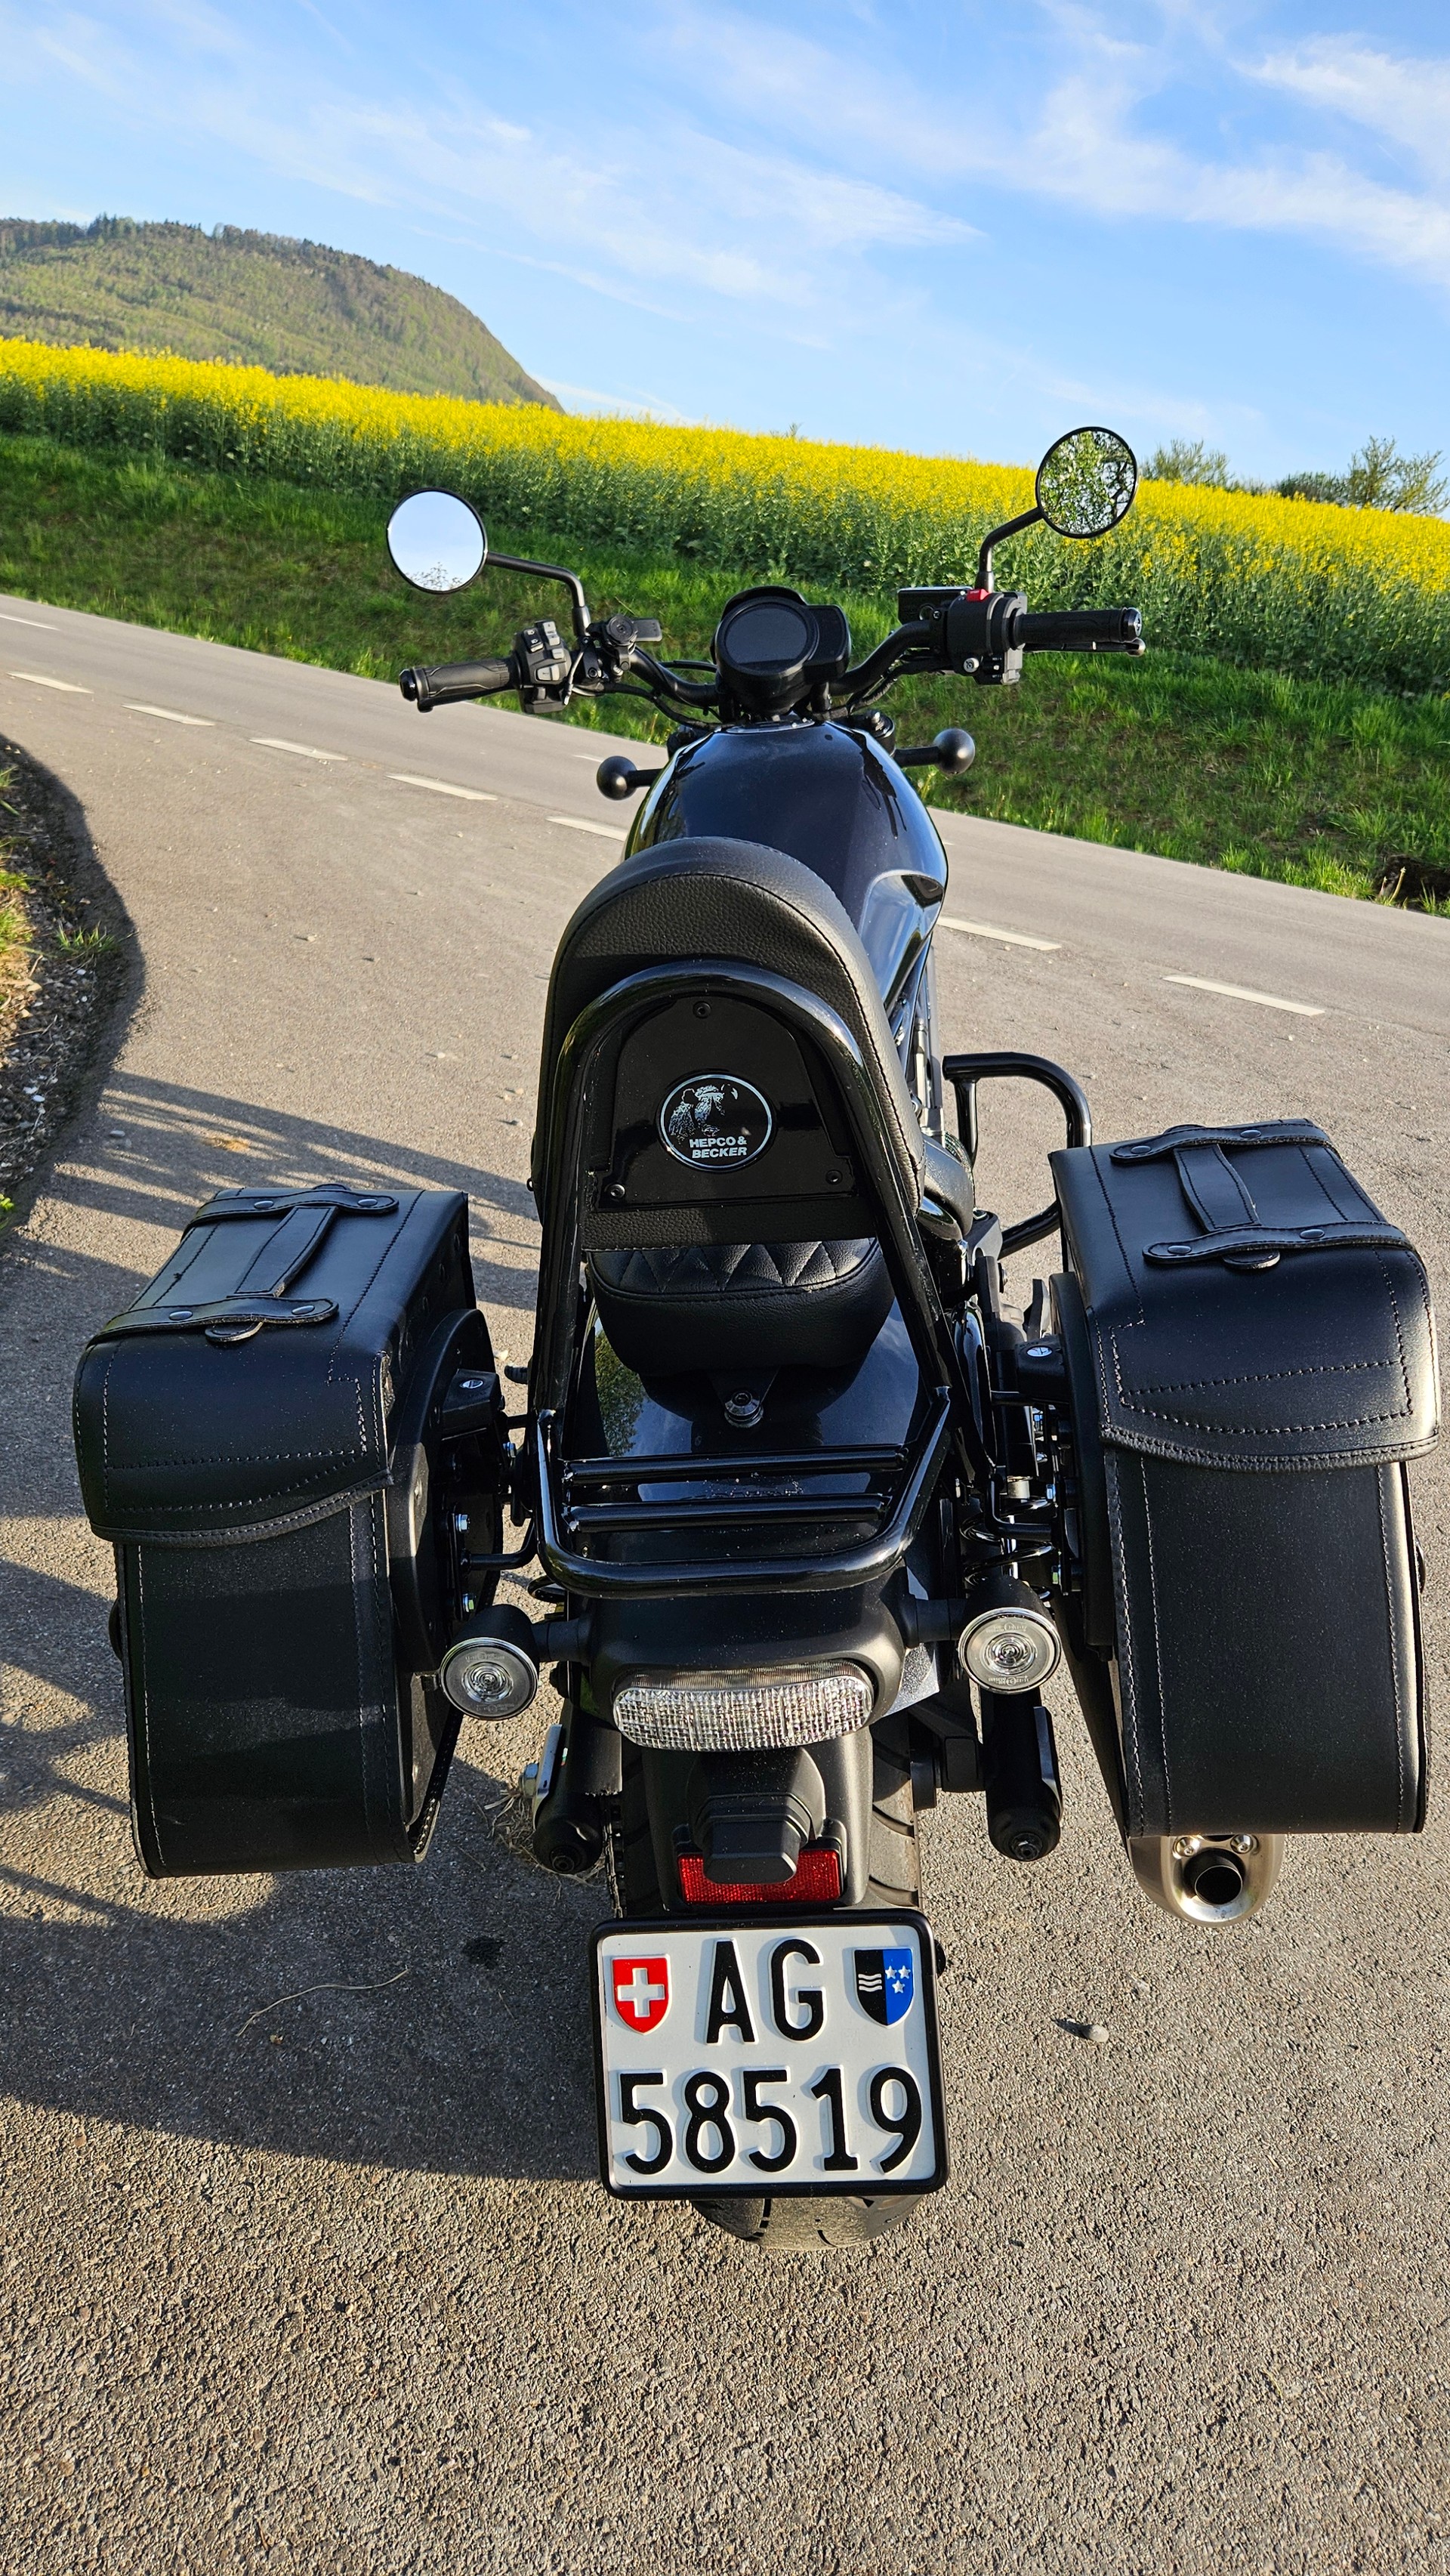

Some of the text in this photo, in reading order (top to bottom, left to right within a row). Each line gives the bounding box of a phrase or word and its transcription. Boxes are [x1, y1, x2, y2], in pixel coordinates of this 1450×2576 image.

[689, 1135, 748, 1148] HEPCO &
[692, 1147, 748, 1159] BECKER
[705, 1938, 825, 2044] AG
[619, 2066, 923, 2176] 58519
